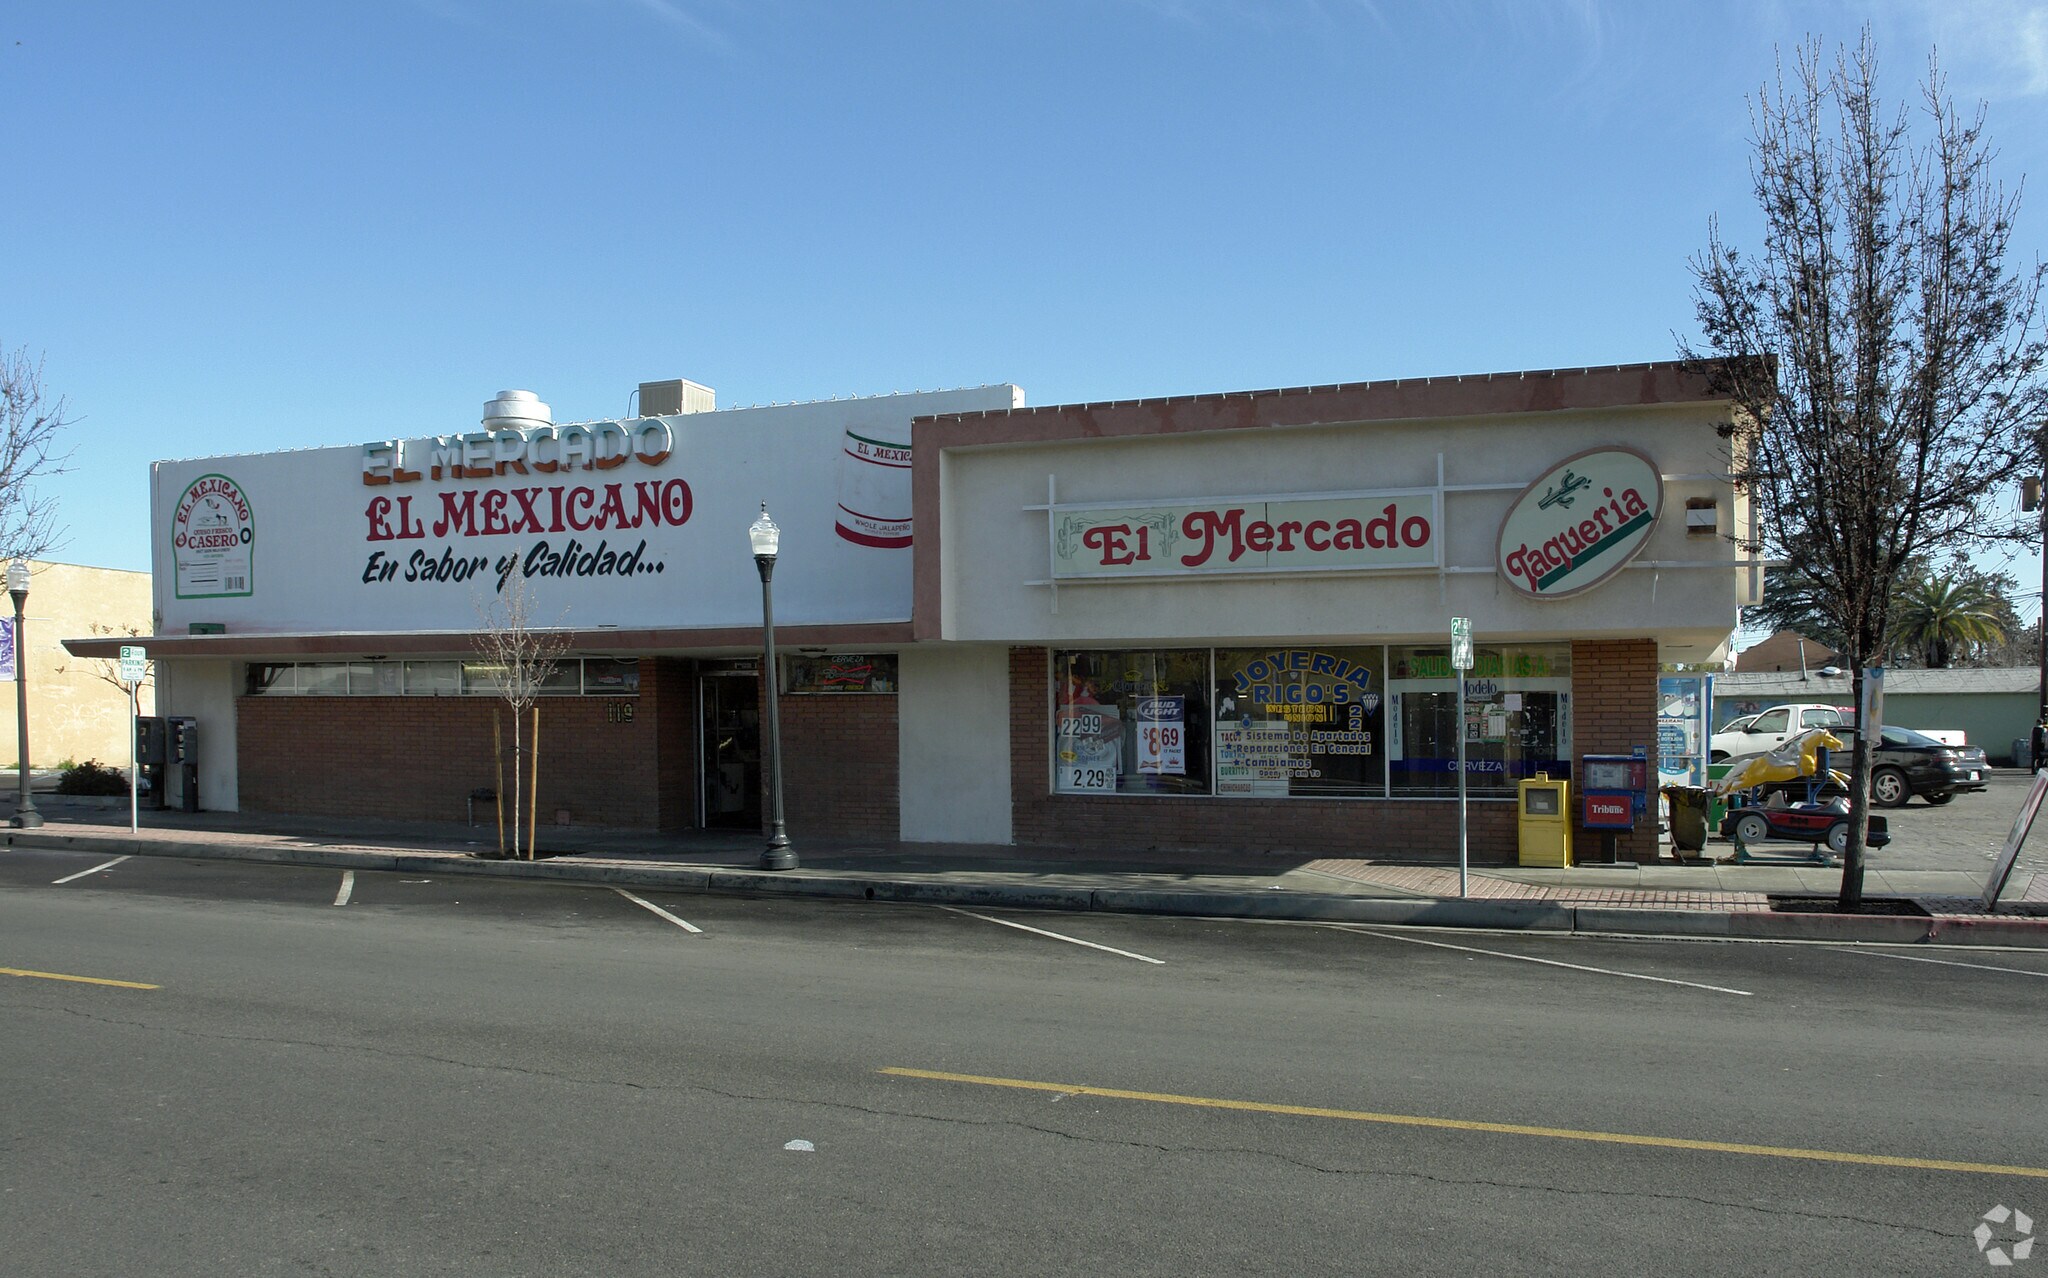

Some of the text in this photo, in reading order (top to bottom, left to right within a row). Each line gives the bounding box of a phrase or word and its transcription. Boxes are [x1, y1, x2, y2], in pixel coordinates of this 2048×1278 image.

[363, 419, 676, 486] EL MERCADO
[858, 442, 912, 462] EL MEXIC
[178, 479, 249, 525] EL MEXICANO
[365, 478, 694, 542] EL MEXICANO
[855, 519, 877, 530] WHOLE
[188, 533, 239, 550] CASERO
[1083, 503, 1431, 567] El Mercado
[1506, 486, 1648, 592] Taqueria
[362, 539, 665, 594] En Sabor y Calidad...
[1452, 622, 1459, 635] 2
[123, 648, 130, 657] 2
[831, 655, 864, 663] CERVEZA
[1231, 650, 1371, 691] JOYERIA
[1253, 683, 1350, 705] RIGO'S
[607, 702, 633, 723] 119
[1144, 707, 1180, 716] LIGHT
[1265, 704, 1325, 714] WESTERN
[1283, 713, 1325, 723] UNION
[1560, 692, 1568, 745] Modelo
[1391, 694, 1399, 746] Modelo
[1246, 730, 1371, 742] Sistema De Apartados
[1236, 743, 1372, 755] Reparaciones En General
[1245, 758, 1312, 768] Cambiamos
[1073, 769, 1105, 789] 2.29
[1591, 804, 1625, 815] Tribune
